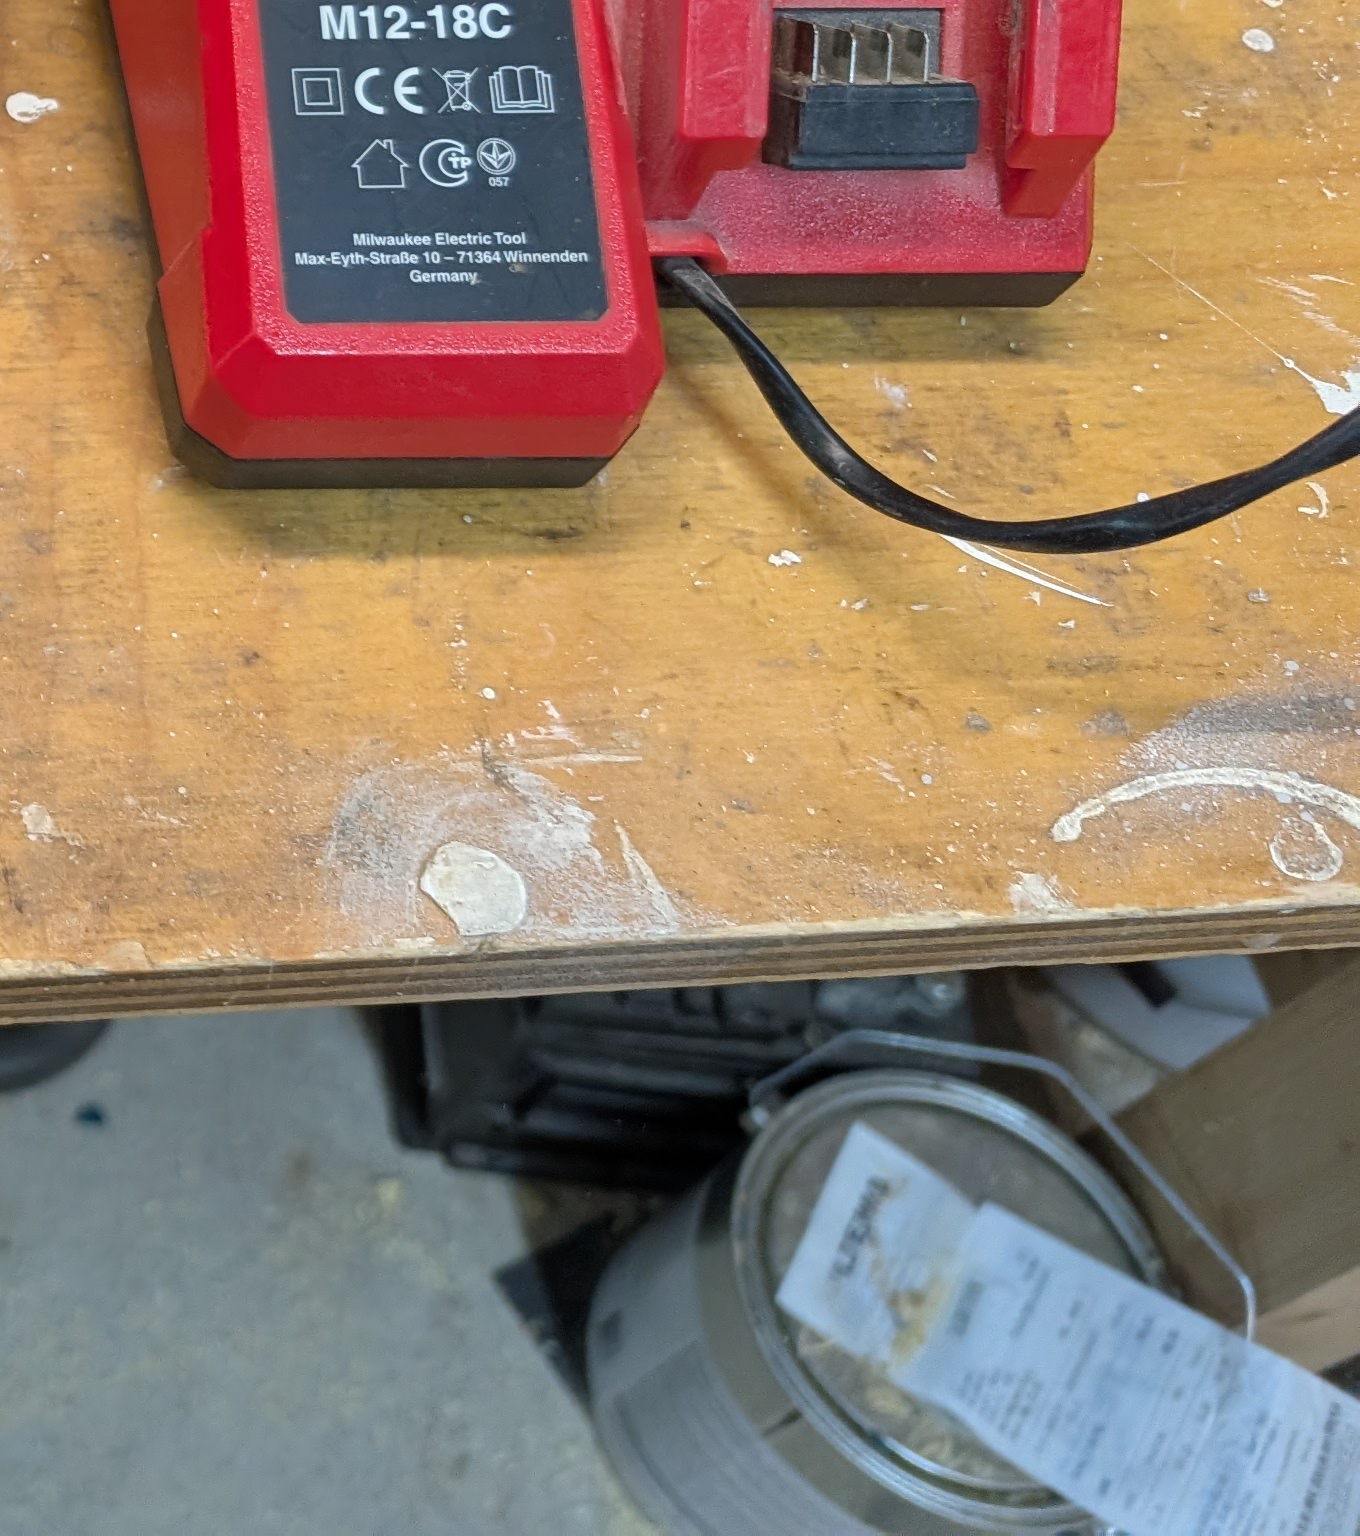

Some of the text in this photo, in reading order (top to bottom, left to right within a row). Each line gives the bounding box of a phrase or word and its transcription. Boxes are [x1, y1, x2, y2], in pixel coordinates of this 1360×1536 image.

[319, 2, 513, 40] M12-18C
[354, 66, 424, 115] CE
[488, 177, 510, 188] 057
[353, 231, 527, 246] Milwaukee Electric Tool
[294, 251, 419, 267] Max-Eyth-Straße
[423, 252, 441, 264] 10
[456, 251, 501, 264] 71364
[504, 250, 588, 264] Winnenden
[409, 269, 479, 286] Germany
